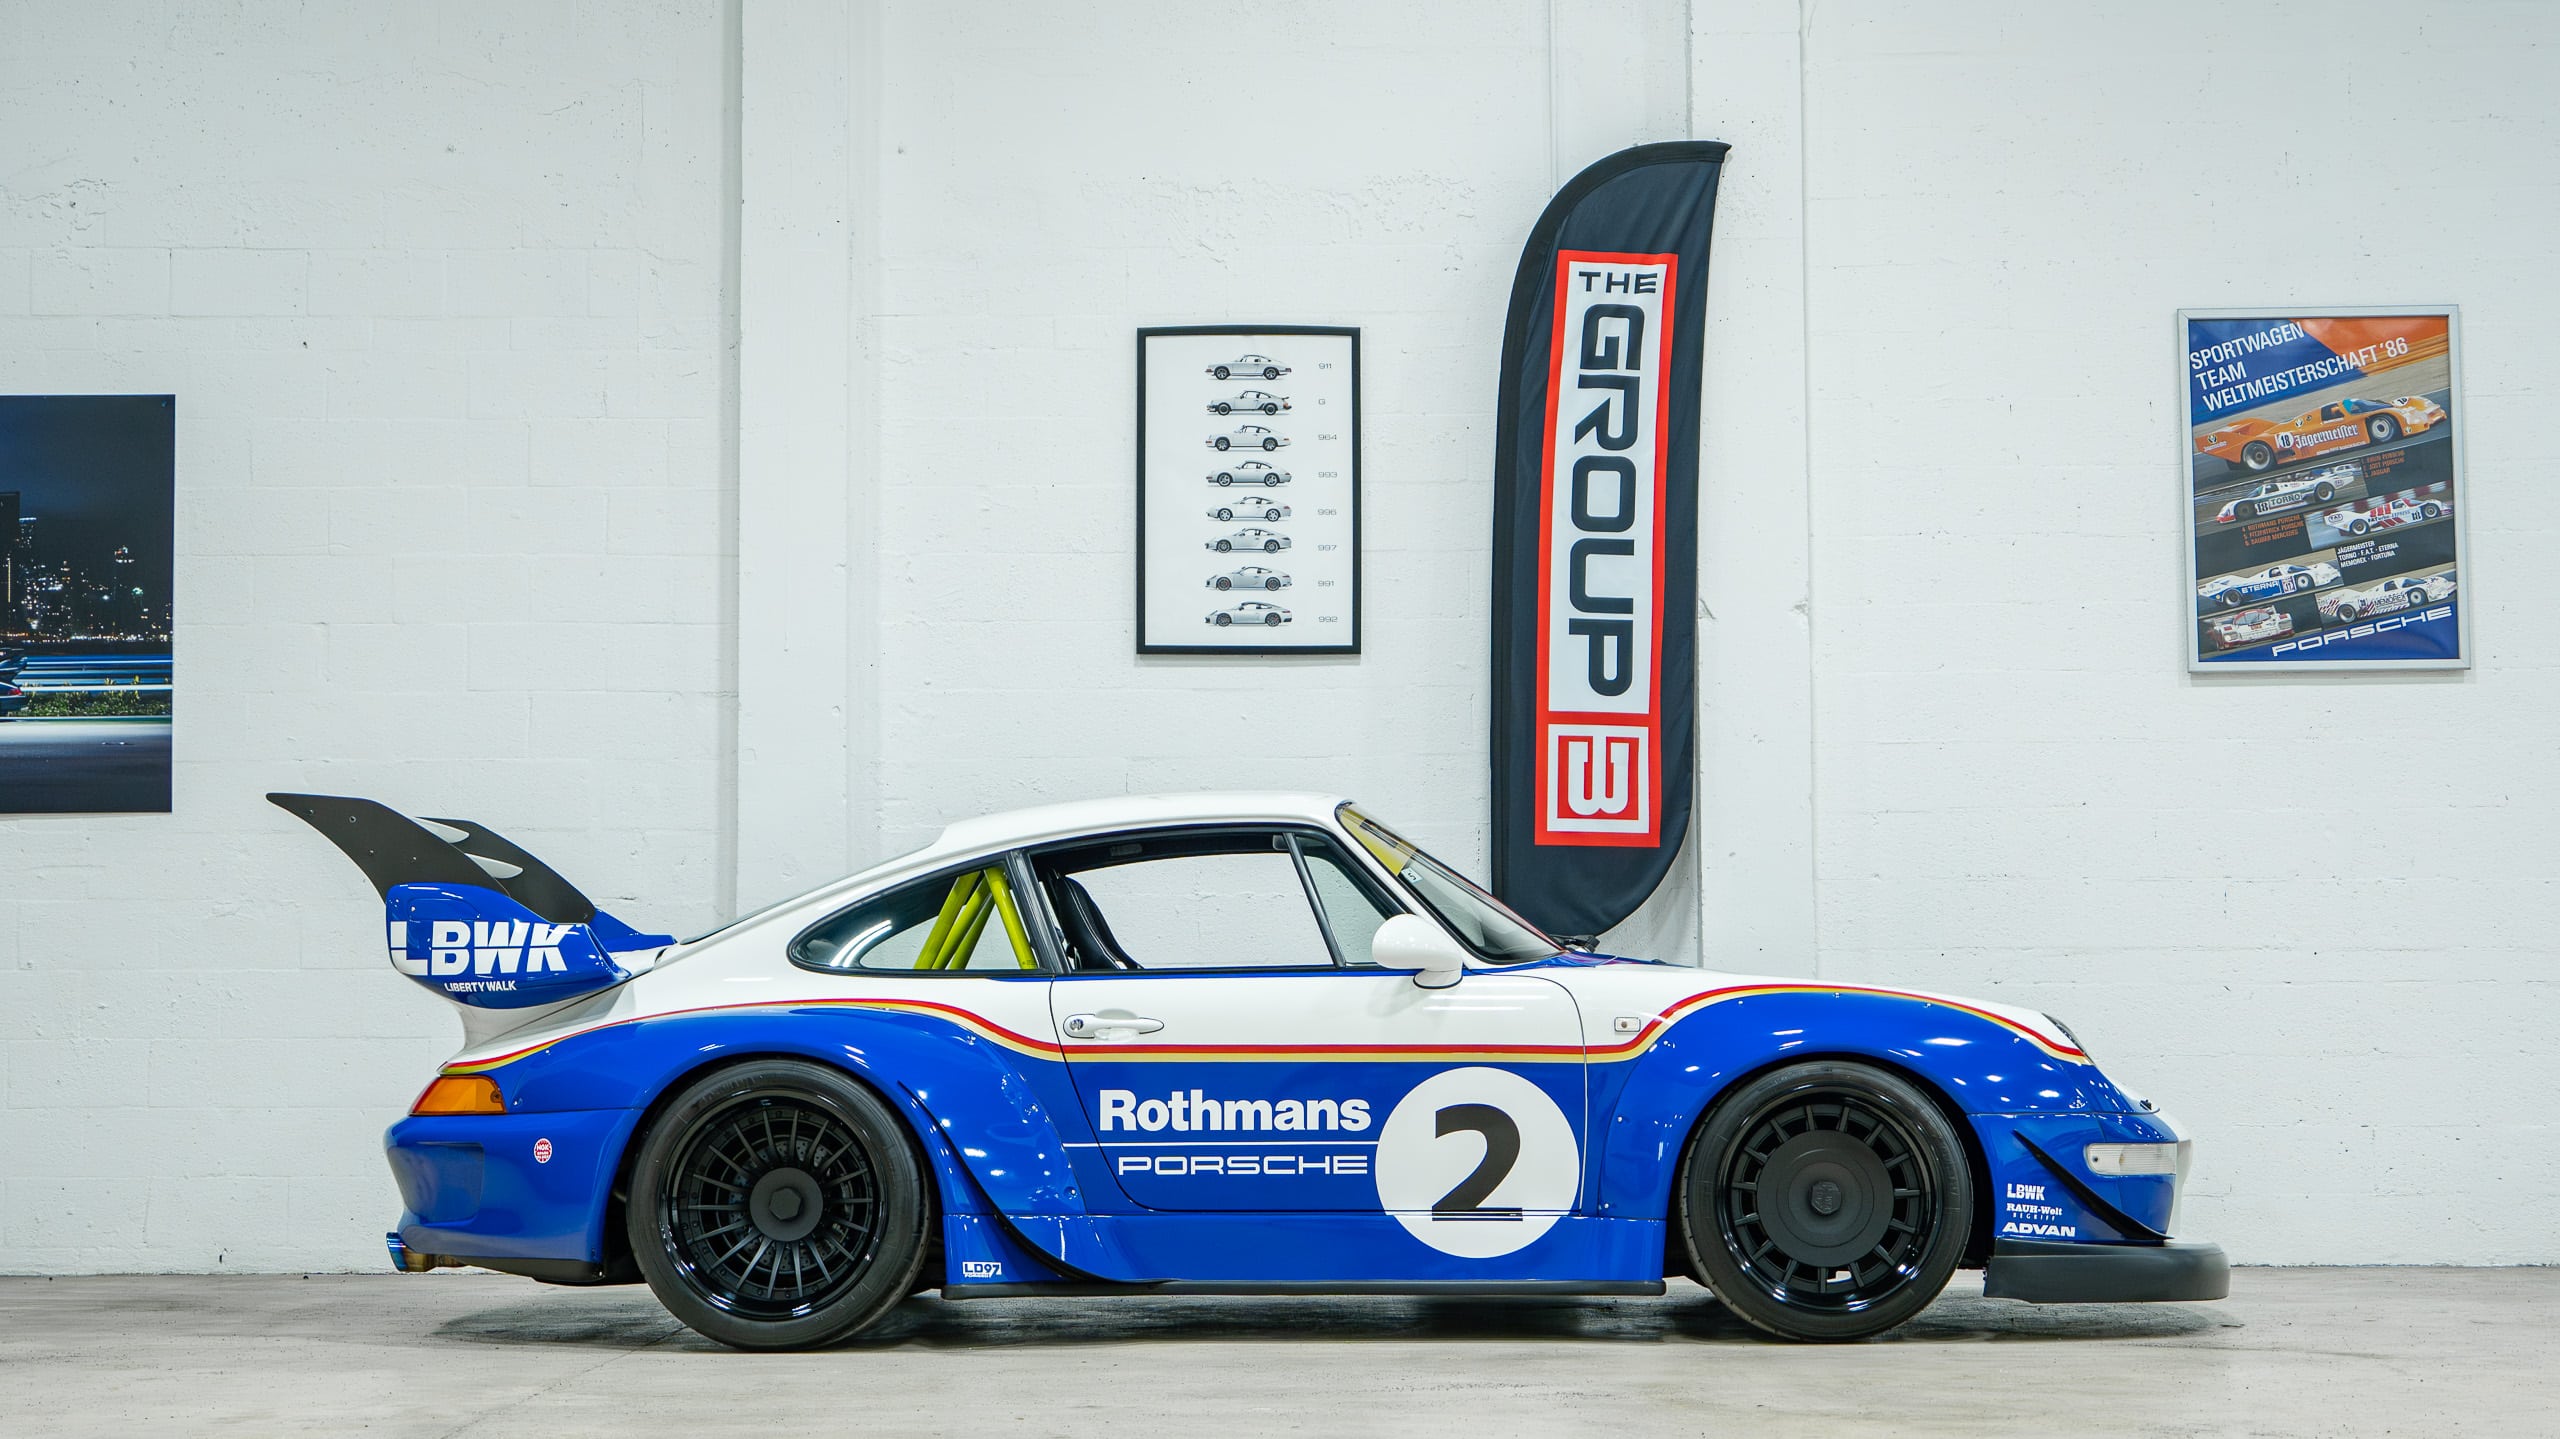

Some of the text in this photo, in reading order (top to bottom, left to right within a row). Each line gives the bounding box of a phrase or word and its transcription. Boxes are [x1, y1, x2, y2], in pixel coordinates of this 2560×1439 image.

[1578, 271, 1658, 294] THE
[2190, 321, 2305, 370] SPORTWAGEN
[2195, 361, 2247, 390] TEAM
[2202, 345, 2378, 412] WELTMEISTERSCHAFT
[2281, 436, 2291, 447] 18
[2294, 424, 2359, 449] Jägermeister
[1569, 303, 1645, 697] GROUP
[2257, 494, 2301, 513] 18 TORNO
[2339, 552, 2357, 561] TORNO
[2379, 542, 2399, 552] ETERNA
[2340, 550, 2396, 568] MEMOREX FORTUNA
[2241, 580, 2279, 594] ETERNA
[2272, 606, 2453, 657] PORSCHE
[390, 921, 575, 976] LBWK
[444, 979, 517, 992] LIBERTY WALK
[1099, 1089, 1372, 1132] Rothmans
[1118, 1155, 1368, 1175] PORSCHE
[1432, 1102, 1523, 1221] 2
[2007, 1183, 2045, 1201] LBWK
[2006, 1203, 2063, 1216] RAUH-Welt
[2002, 1222, 2076, 1237] ADVAN
[964, 1263, 1000, 1276] LD97
